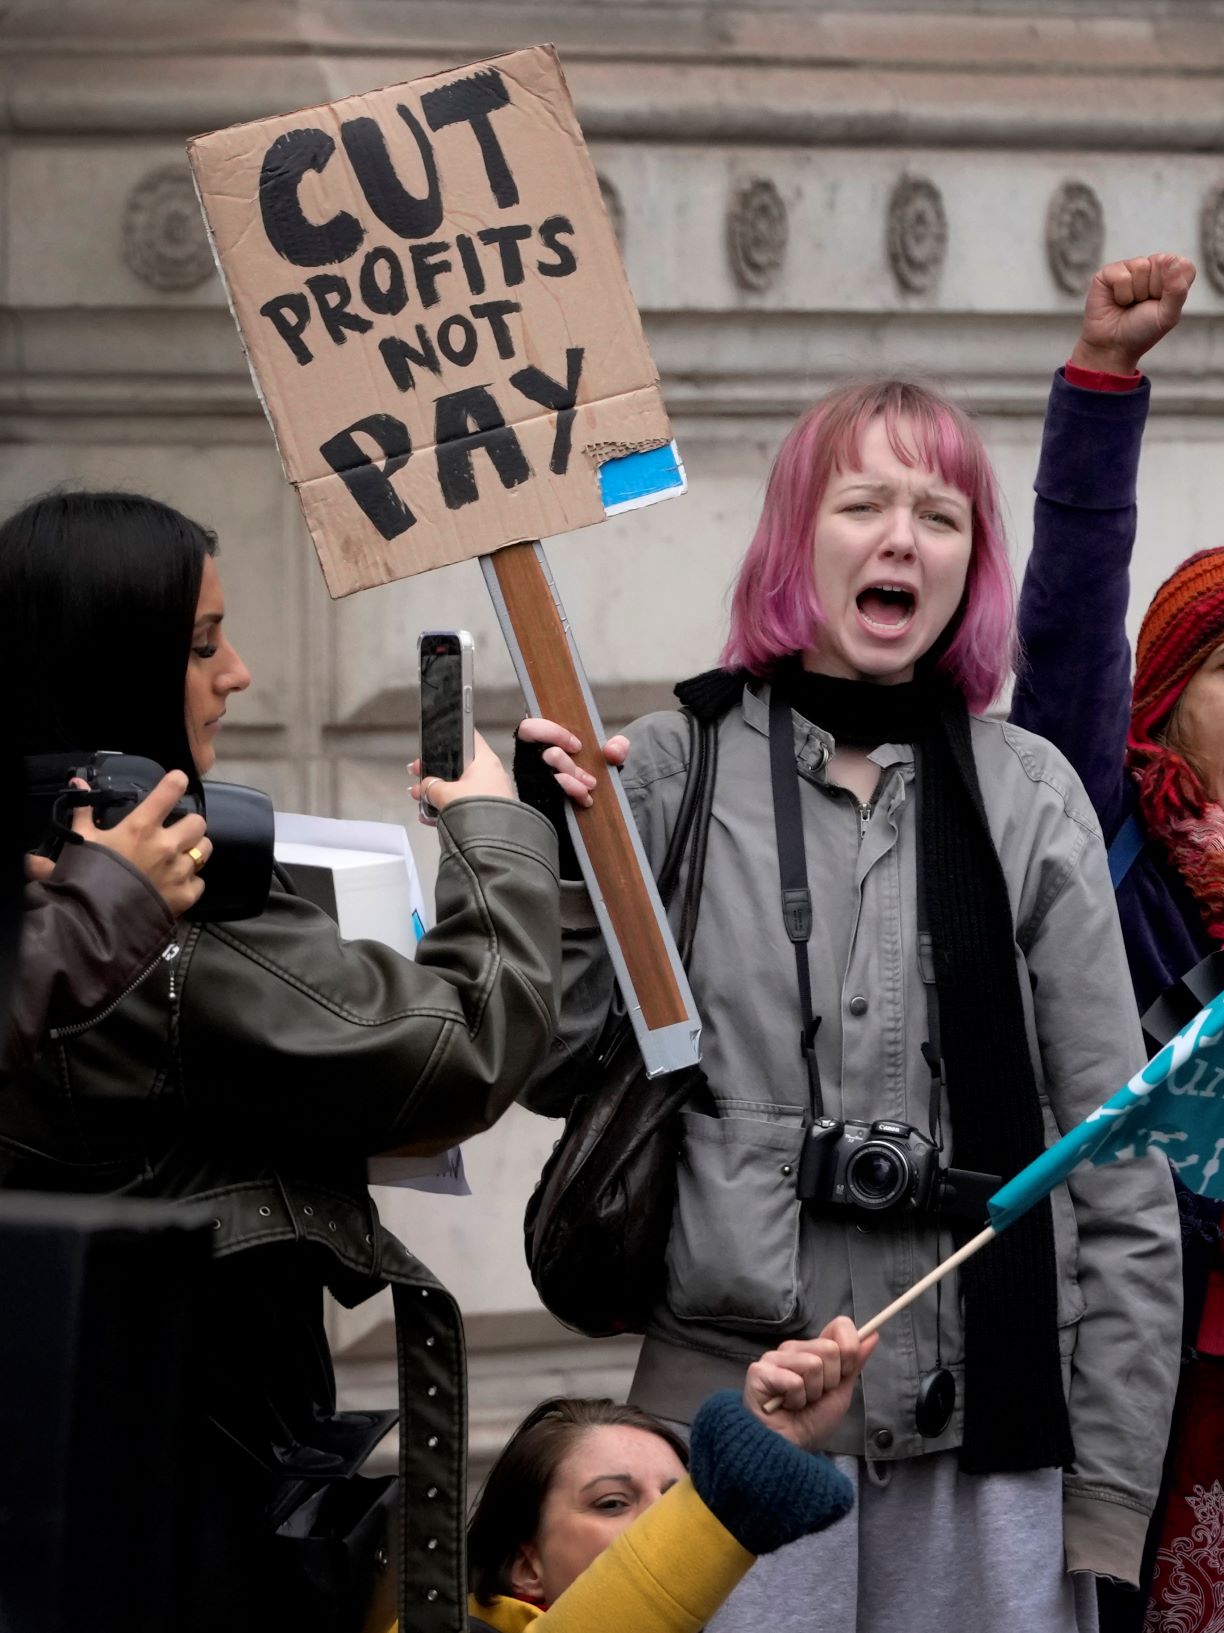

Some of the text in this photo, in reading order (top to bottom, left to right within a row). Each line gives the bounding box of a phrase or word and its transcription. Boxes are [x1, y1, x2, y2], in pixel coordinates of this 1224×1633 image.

[259, 66, 520, 268] CUT
[260, 214, 578, 367] PROFITS
[379, 299, 523, 392] NOT
[319, 347, 586, 542] PAY
